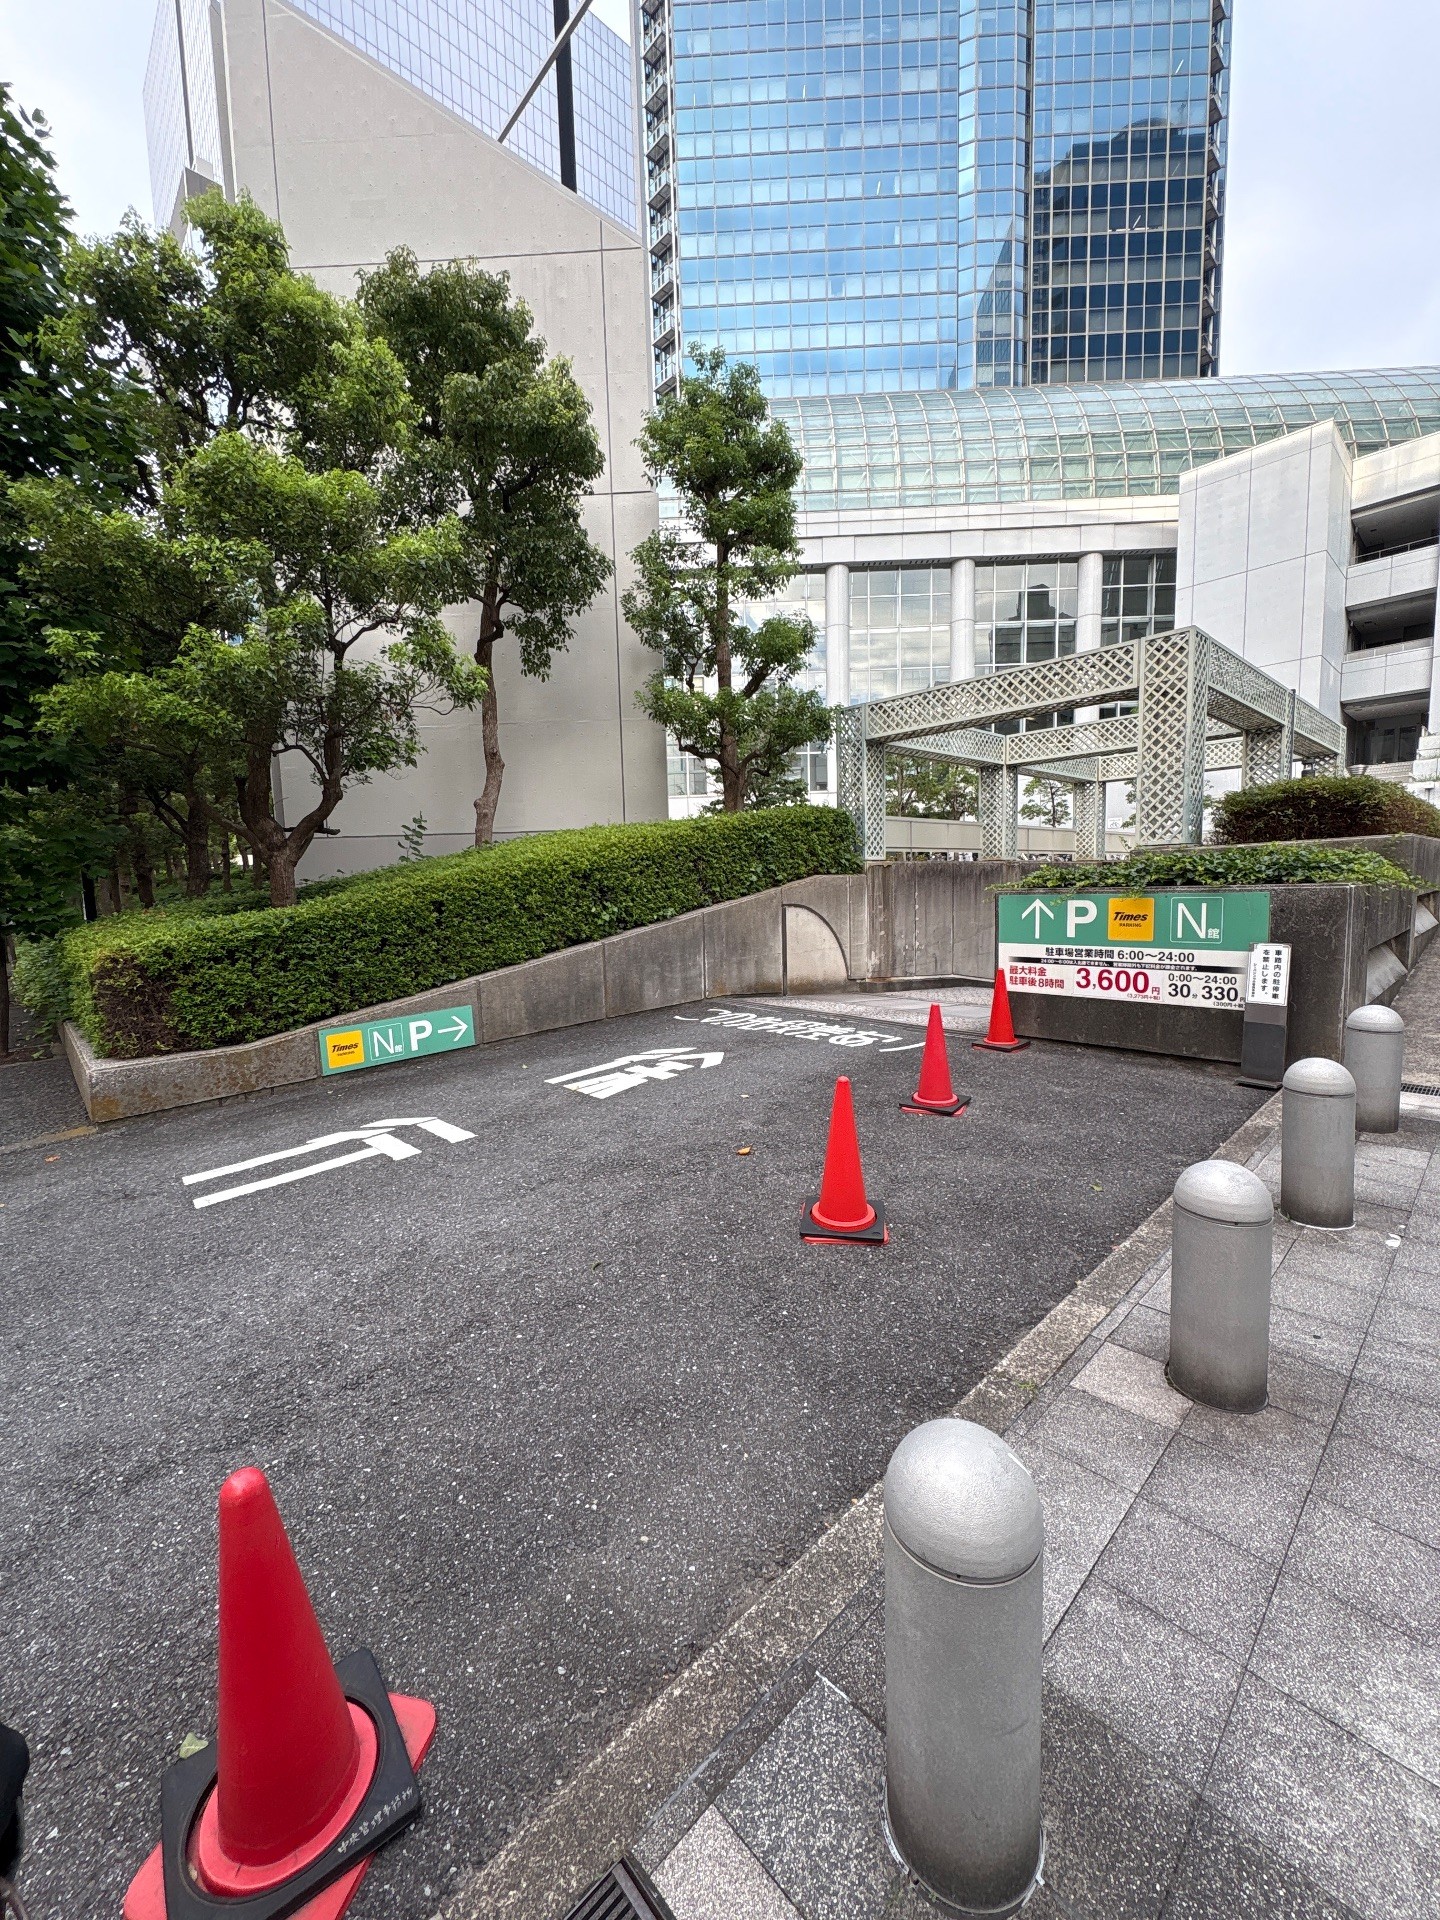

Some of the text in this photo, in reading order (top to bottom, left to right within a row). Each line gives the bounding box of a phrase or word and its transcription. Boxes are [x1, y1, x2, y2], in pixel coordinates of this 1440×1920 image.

[1066, 900, 1220, 939] P Times N館
[1045, 947, 1115, 960] 駐車場営業時間
[1009, 965, 1047, 977] 最大料金
[1009, 976, 1065, 989] 駐車後8時間
[331, 1042, 359, 1053] Times
[409, 1019, 433, 1052] P
